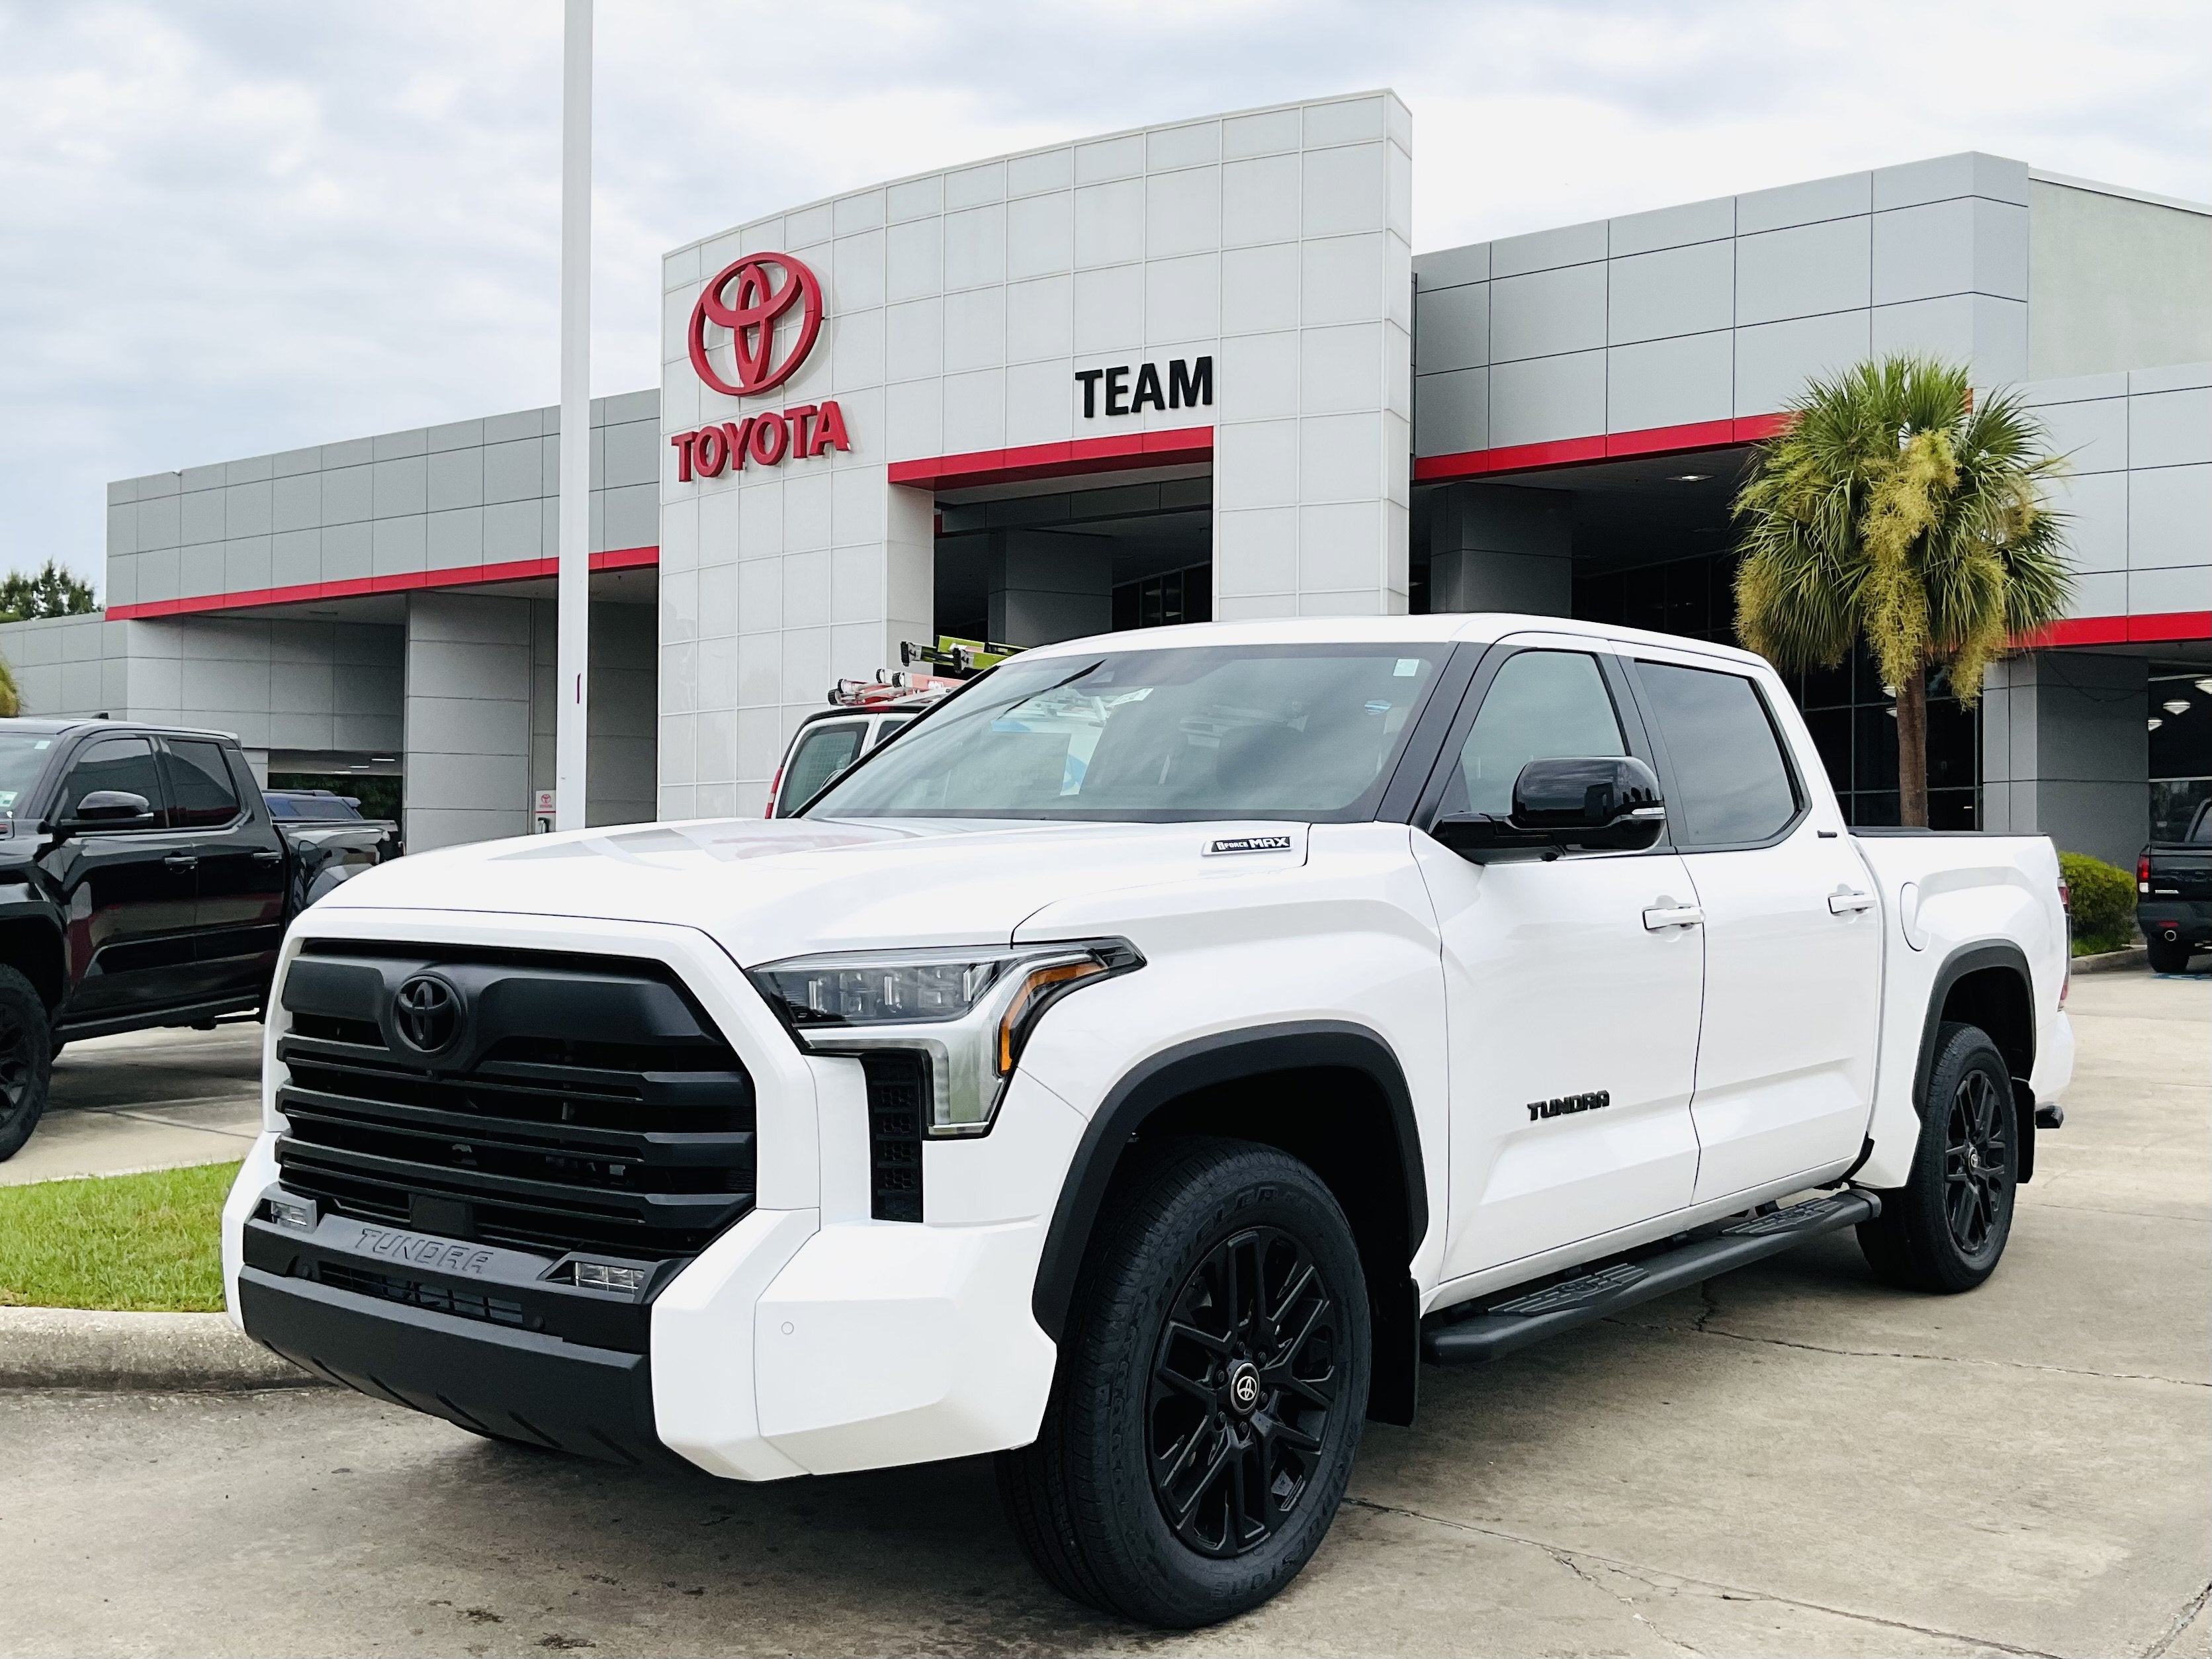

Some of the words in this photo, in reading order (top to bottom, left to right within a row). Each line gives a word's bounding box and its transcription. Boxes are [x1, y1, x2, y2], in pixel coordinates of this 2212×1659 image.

[1075, 355, 1212, 418] TEAM
[671, 400, 850, 482] TOYOTA
[1248, 837, 1289, 848] MAX
[1527, 1089, 1610, 1121] TUNDRA
[355, 1228, 494, 1274] TUNDRA
